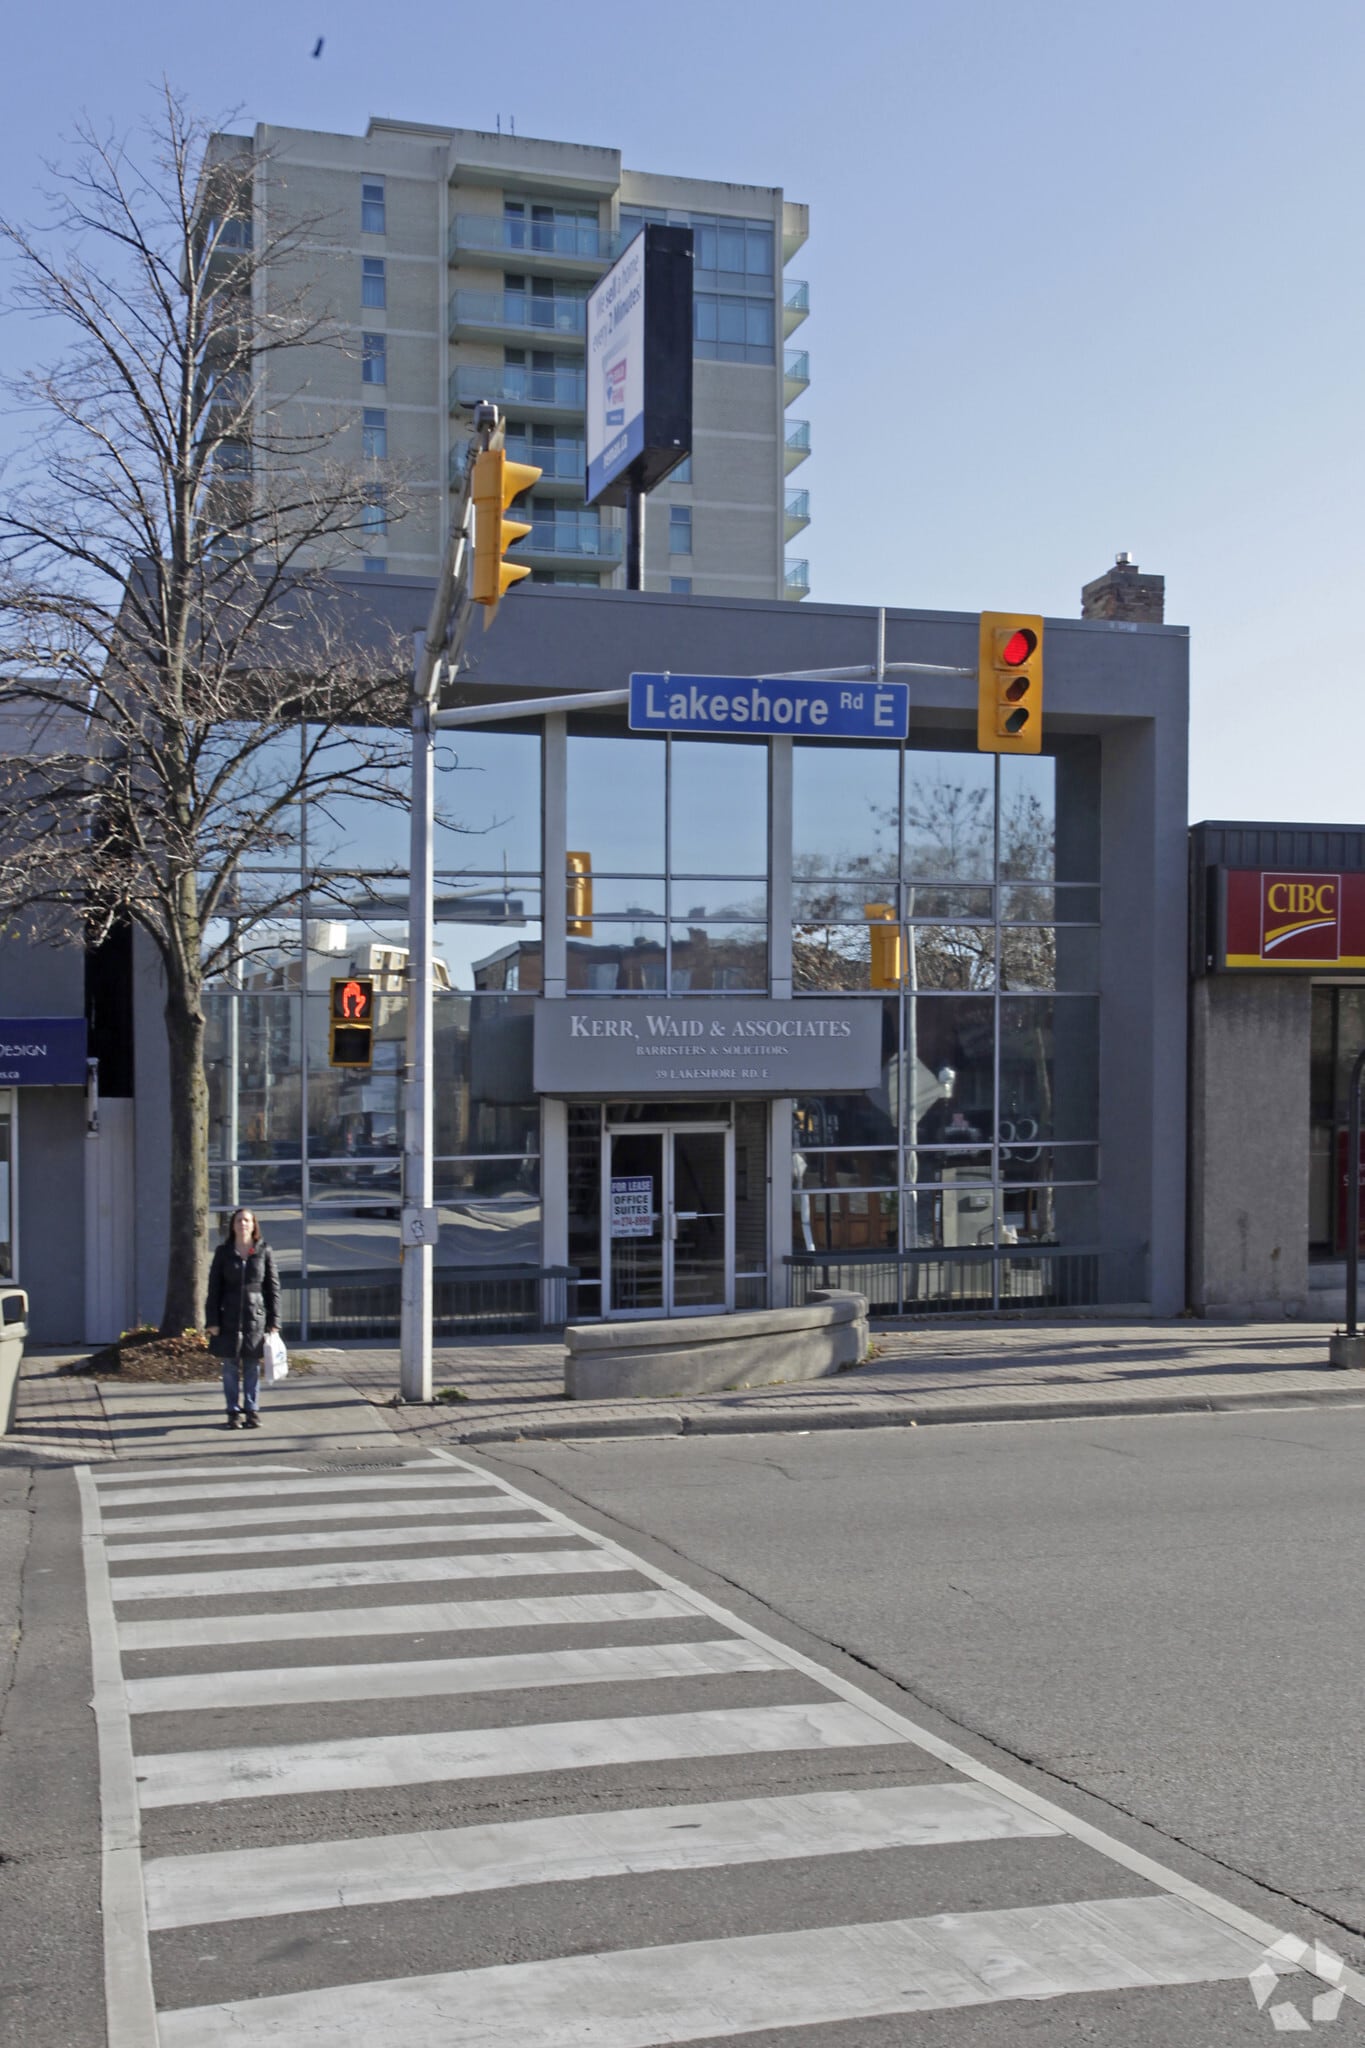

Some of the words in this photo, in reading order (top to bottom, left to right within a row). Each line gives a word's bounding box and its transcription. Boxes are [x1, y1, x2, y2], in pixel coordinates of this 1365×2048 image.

[646, 684, 829, 726] Lakeshore
[840, 692, 864, 711] Rd
[874, 694, 895, 727] E
[1268, 883, 1335, 914] CIBC
[709, 1020, 726, 1037] &
[732, 1020, 852, 1038] ASSOCIATES
[636, 1045, 706, 1056] BARRISTERS
[709, 1046, 719, 1055] &
[722, 1045, 789, 1056] SOLICITORS
[655, 1069, 668, 1079] 39
[669, 1068, 737, 1079] LAKESHORE
[762, 1068, 769, 1079] E
[611, 1182, 627, 1192] FOR
[628, 1180, 651, 1191] LEASE
[614, 1195, 649, 1205] OFFICE
[615, 1205, 649, 1215] SUITES
